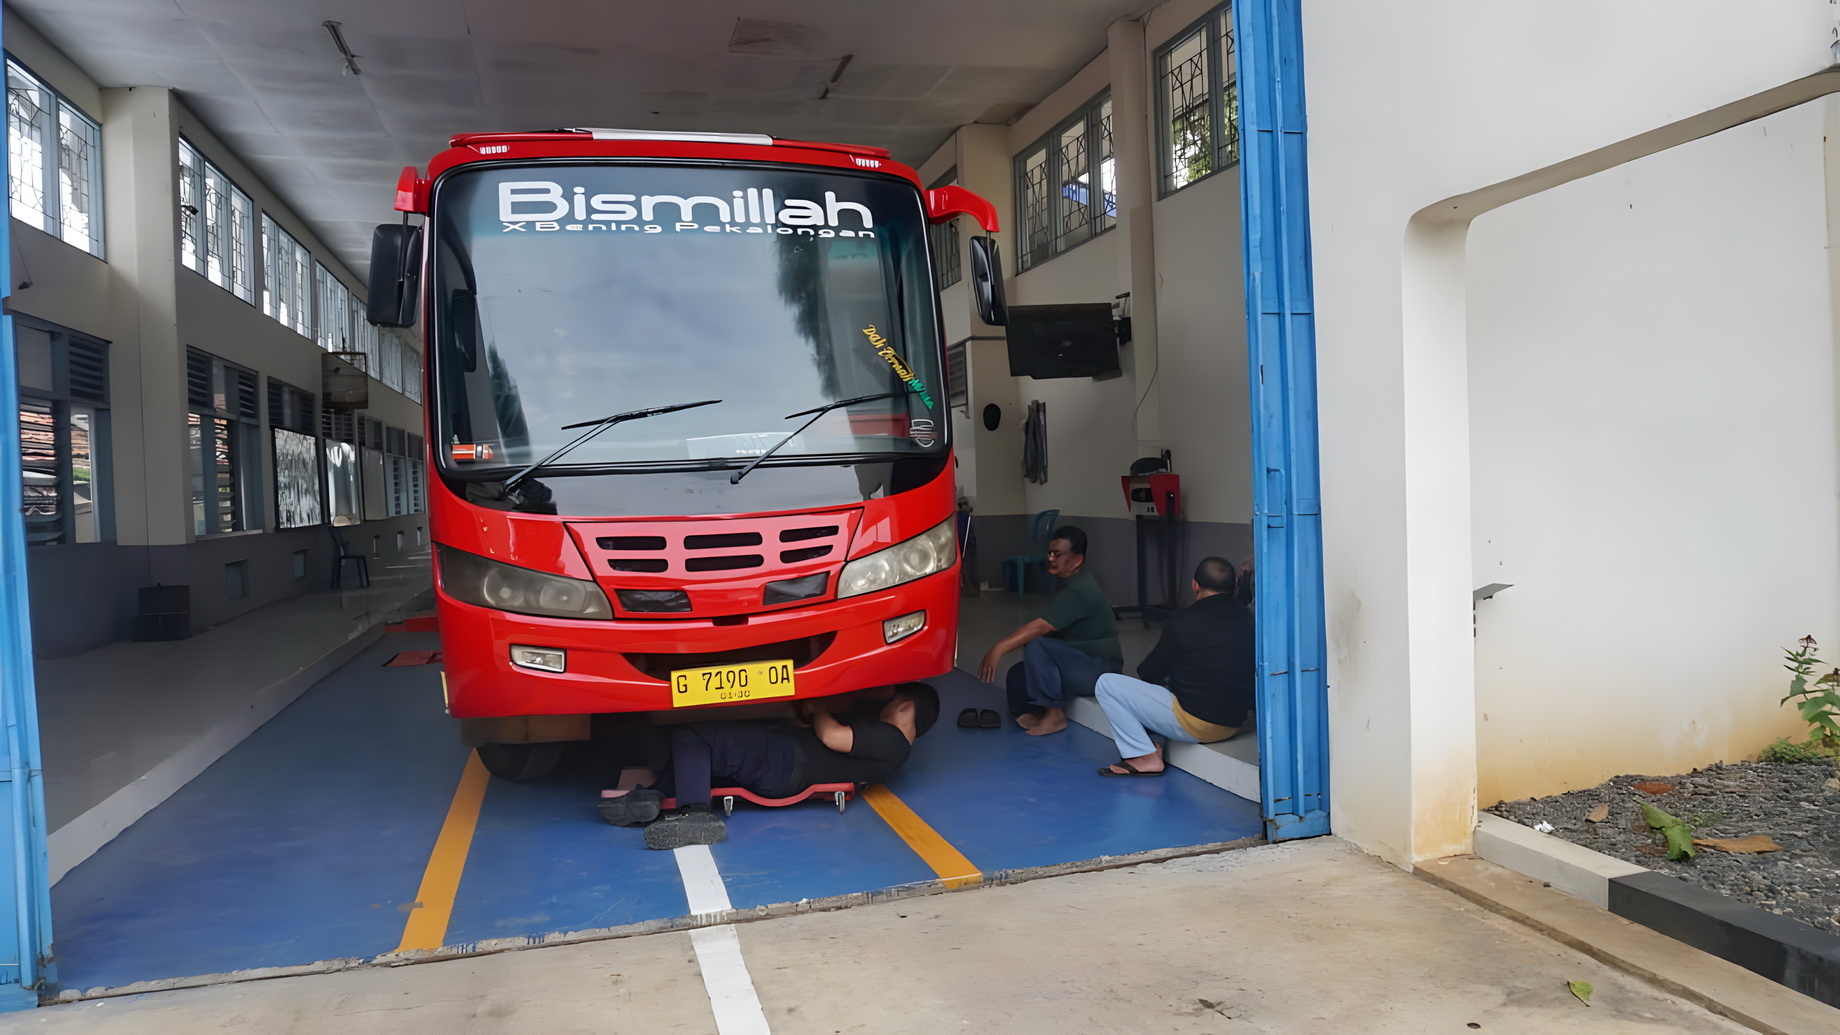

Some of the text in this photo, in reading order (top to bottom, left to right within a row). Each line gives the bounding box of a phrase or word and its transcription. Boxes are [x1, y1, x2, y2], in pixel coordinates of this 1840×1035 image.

[498, 181, 875, 229] Bismillah
[535, 221, 663, 234] Bening
[675, 222, 876, 239] Pekalongan
[676, 664, 791, 694] G 7190 OA
